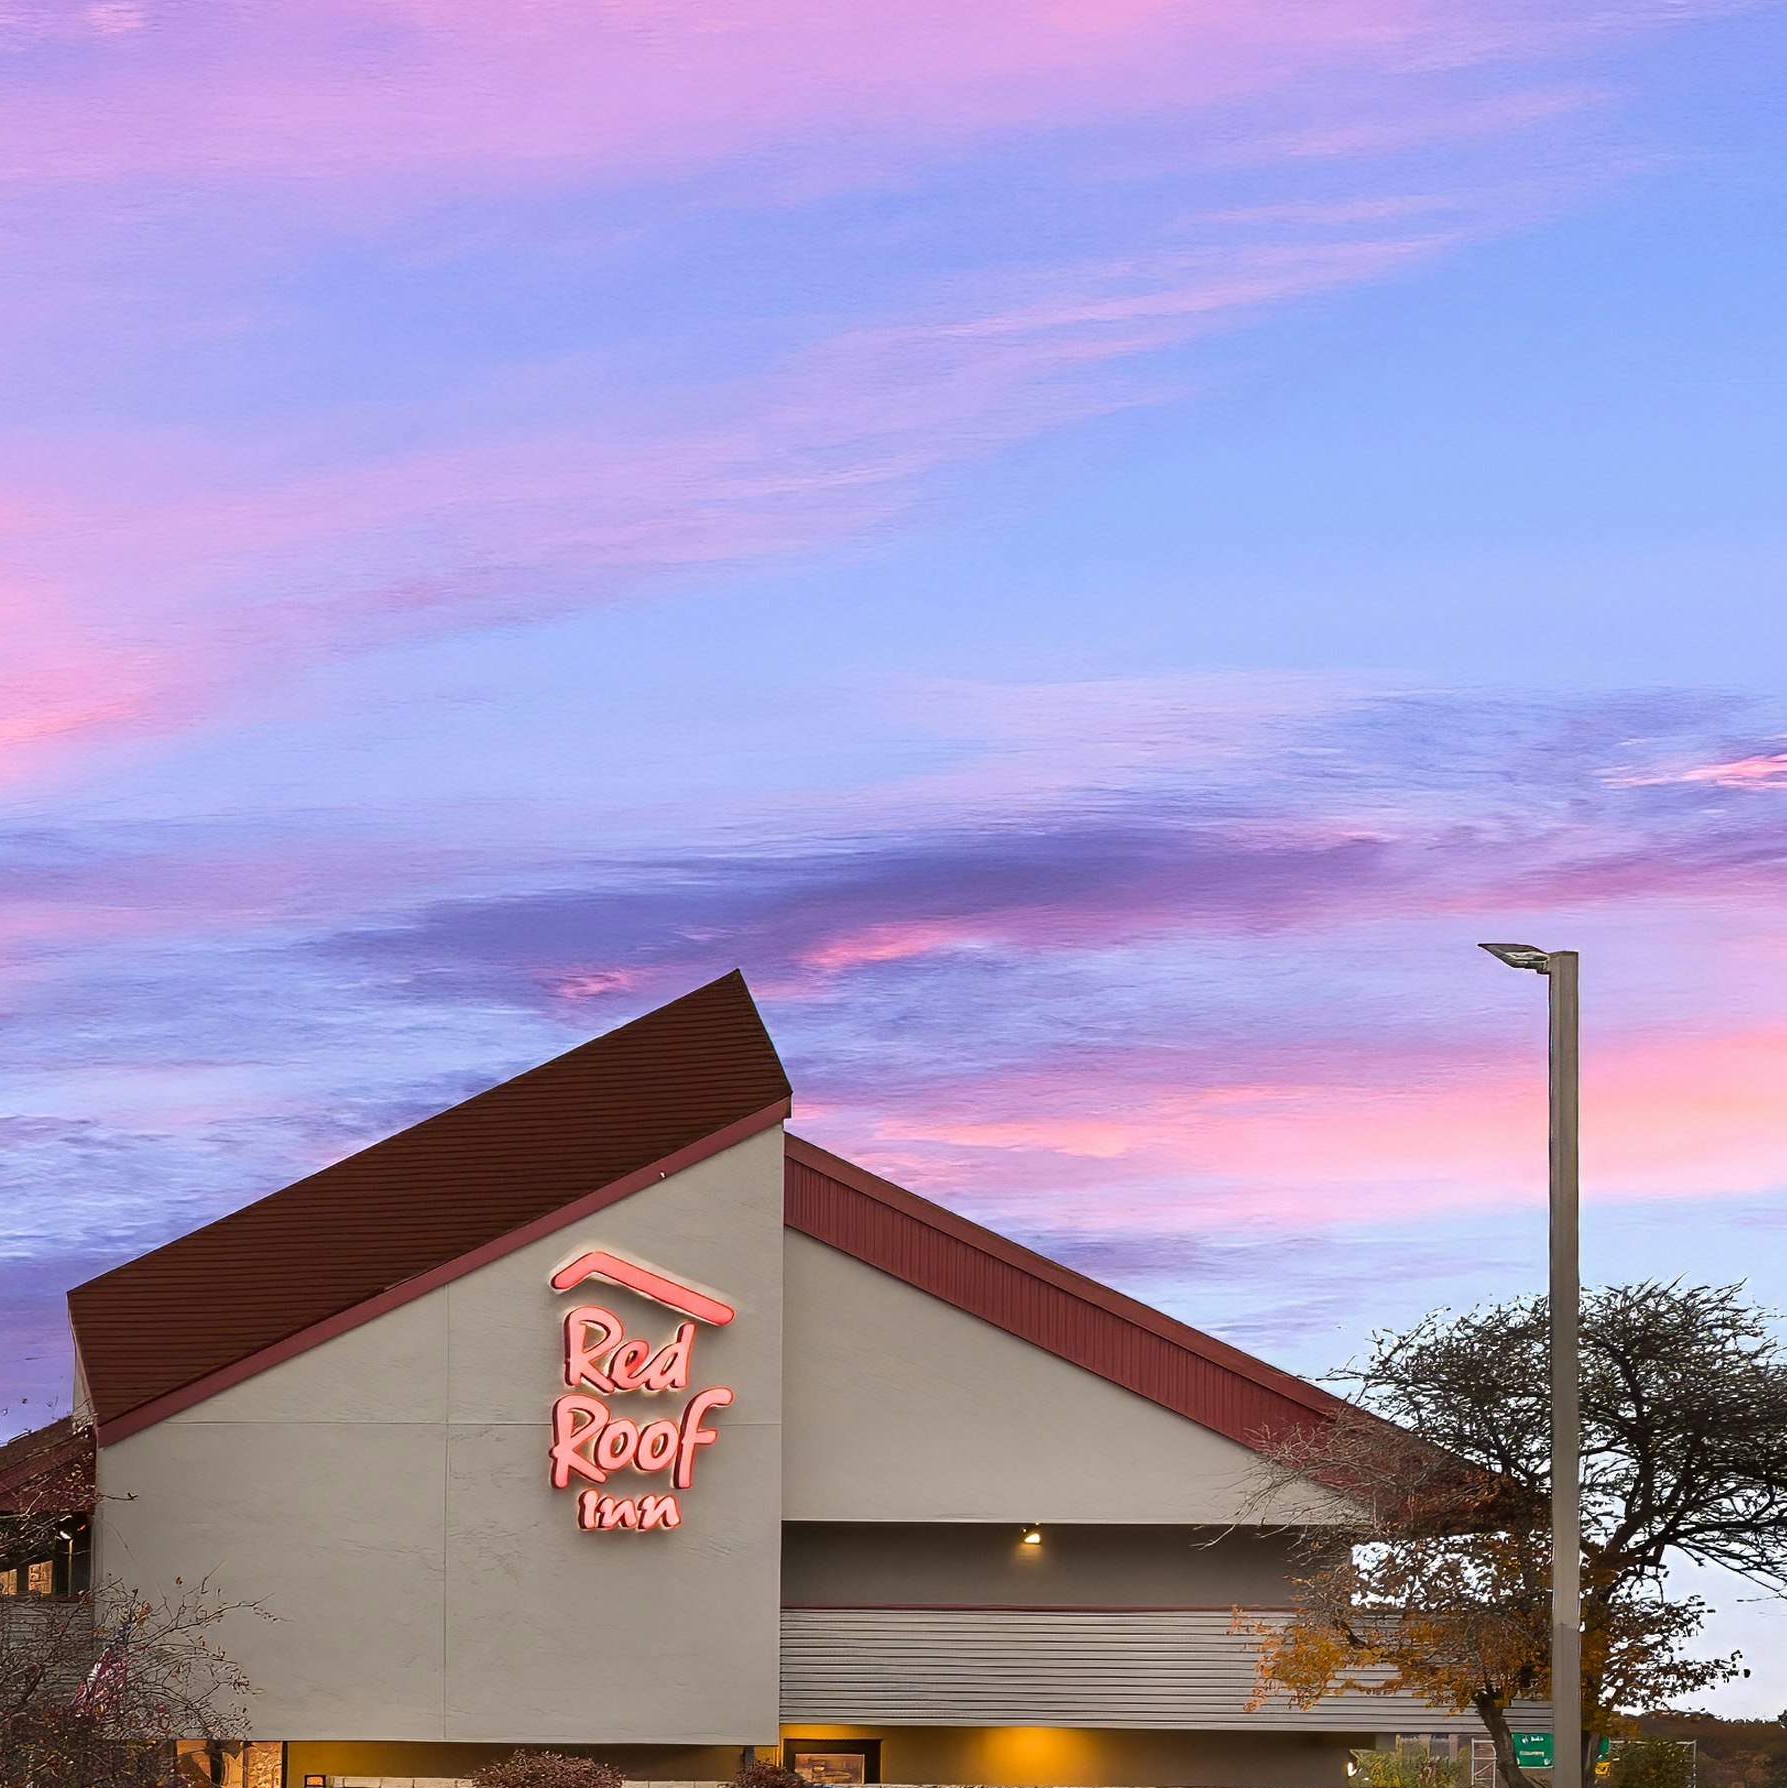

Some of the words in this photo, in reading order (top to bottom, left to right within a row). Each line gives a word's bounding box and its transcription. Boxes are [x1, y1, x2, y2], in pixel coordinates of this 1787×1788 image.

[565, 1306, 696, 1393] Red
[550, 1387, 734, 1489] Roof
[578, 1488, 681, 1530] Inn
